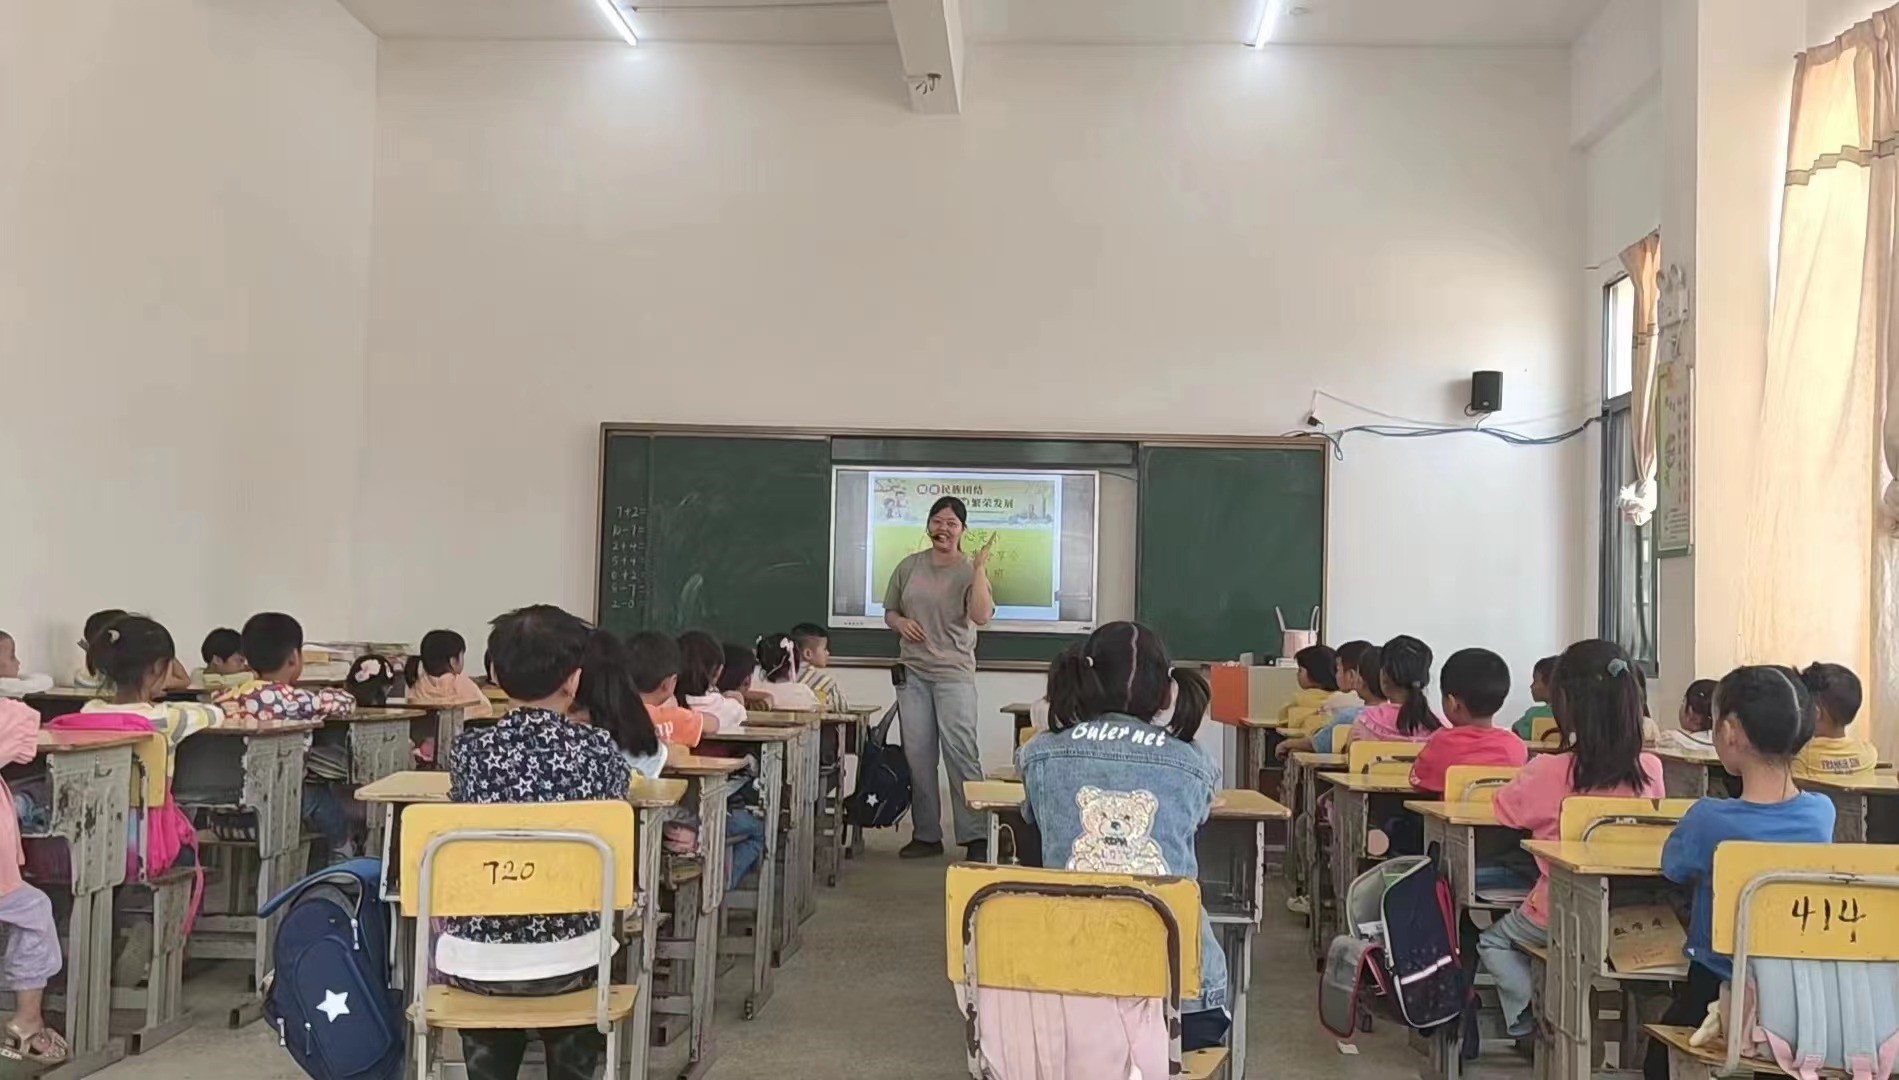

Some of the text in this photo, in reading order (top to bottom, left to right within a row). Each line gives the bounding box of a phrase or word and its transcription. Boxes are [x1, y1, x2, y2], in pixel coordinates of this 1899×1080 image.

[1131, 729, 1167, 747] net
[483, 860, 535, 885] 720
[1791, 895, 1867, 943] 414
